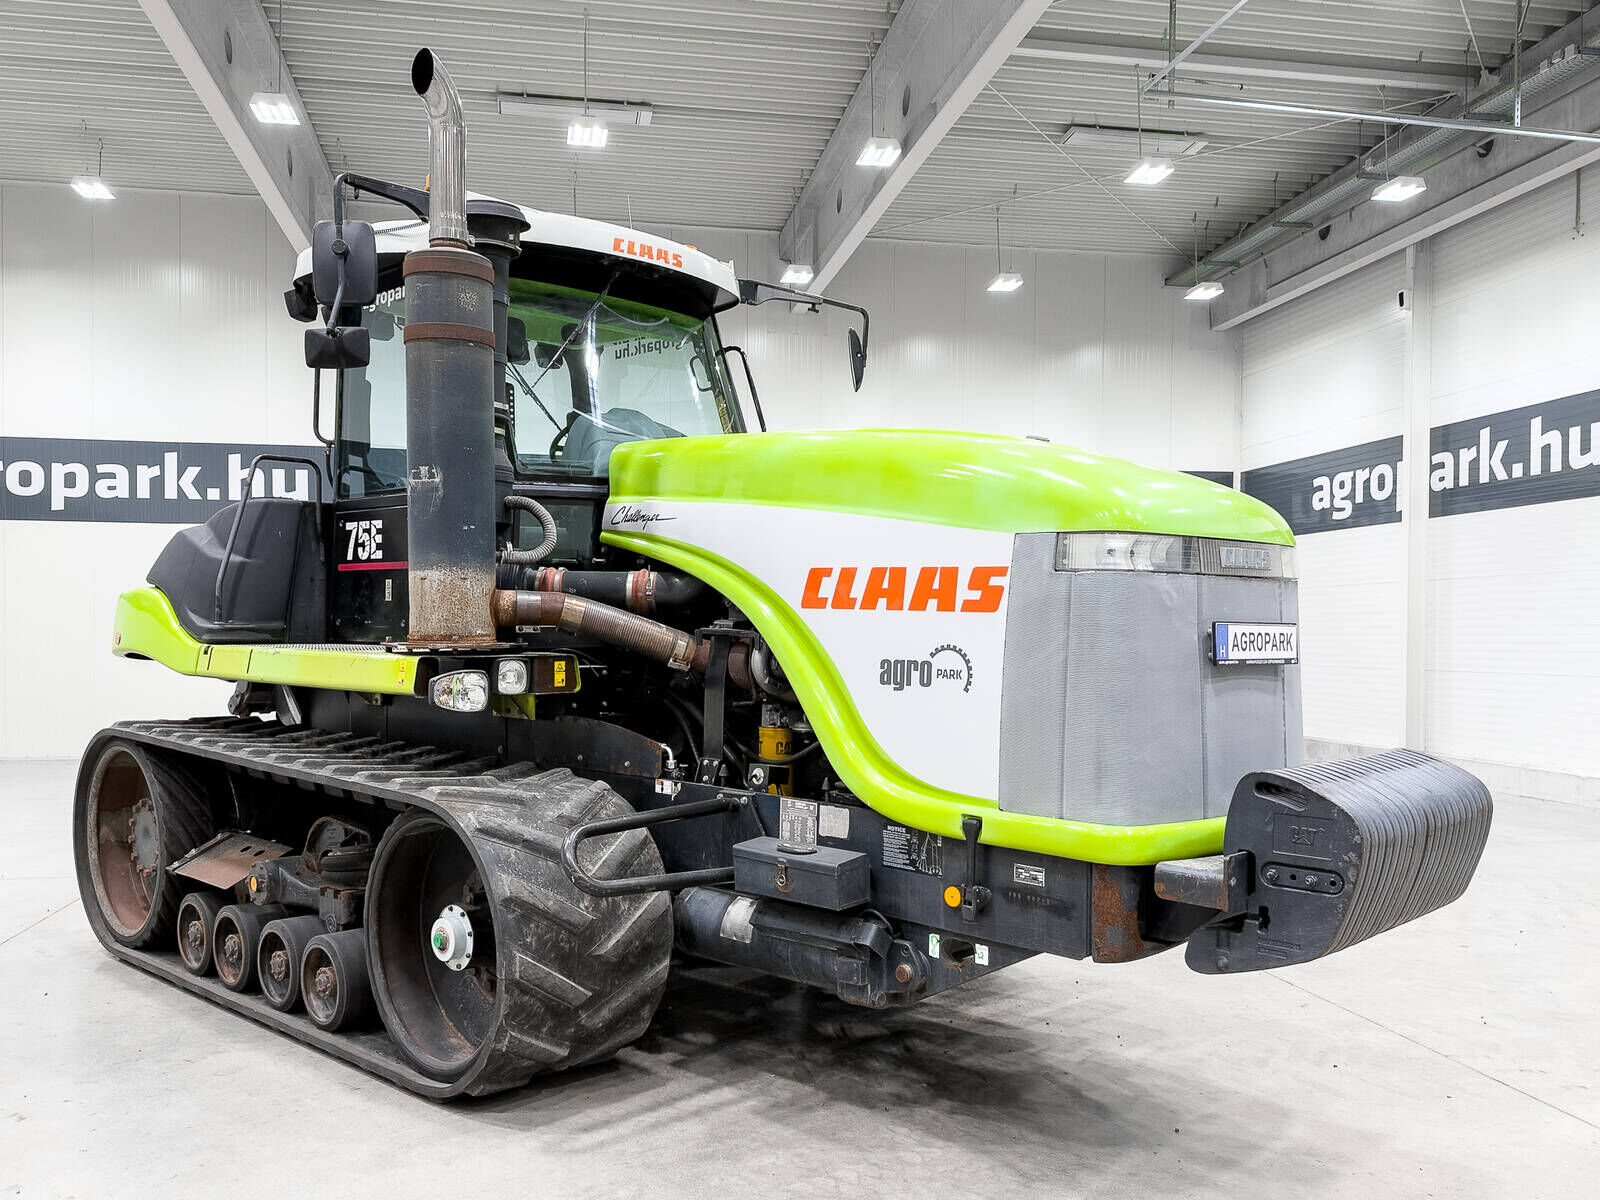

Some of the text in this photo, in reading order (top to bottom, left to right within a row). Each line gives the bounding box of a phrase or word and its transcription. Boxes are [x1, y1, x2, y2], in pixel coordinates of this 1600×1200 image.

[612, 237, 684, 269] CLAAS
[0, 451, 309, 511] opark.hu
[610, 505, 678, 531] Challenger
[345, 519, 384, 561] 75E
[801, 566, 1010, 613] CLAAS
[1219, 645, 1227, 658] H
[1231, 631, 1294, 653] AGROPARK
[879, 658, 963, 692] agro PARK
[887, 825, 907, 834] NOTICE
